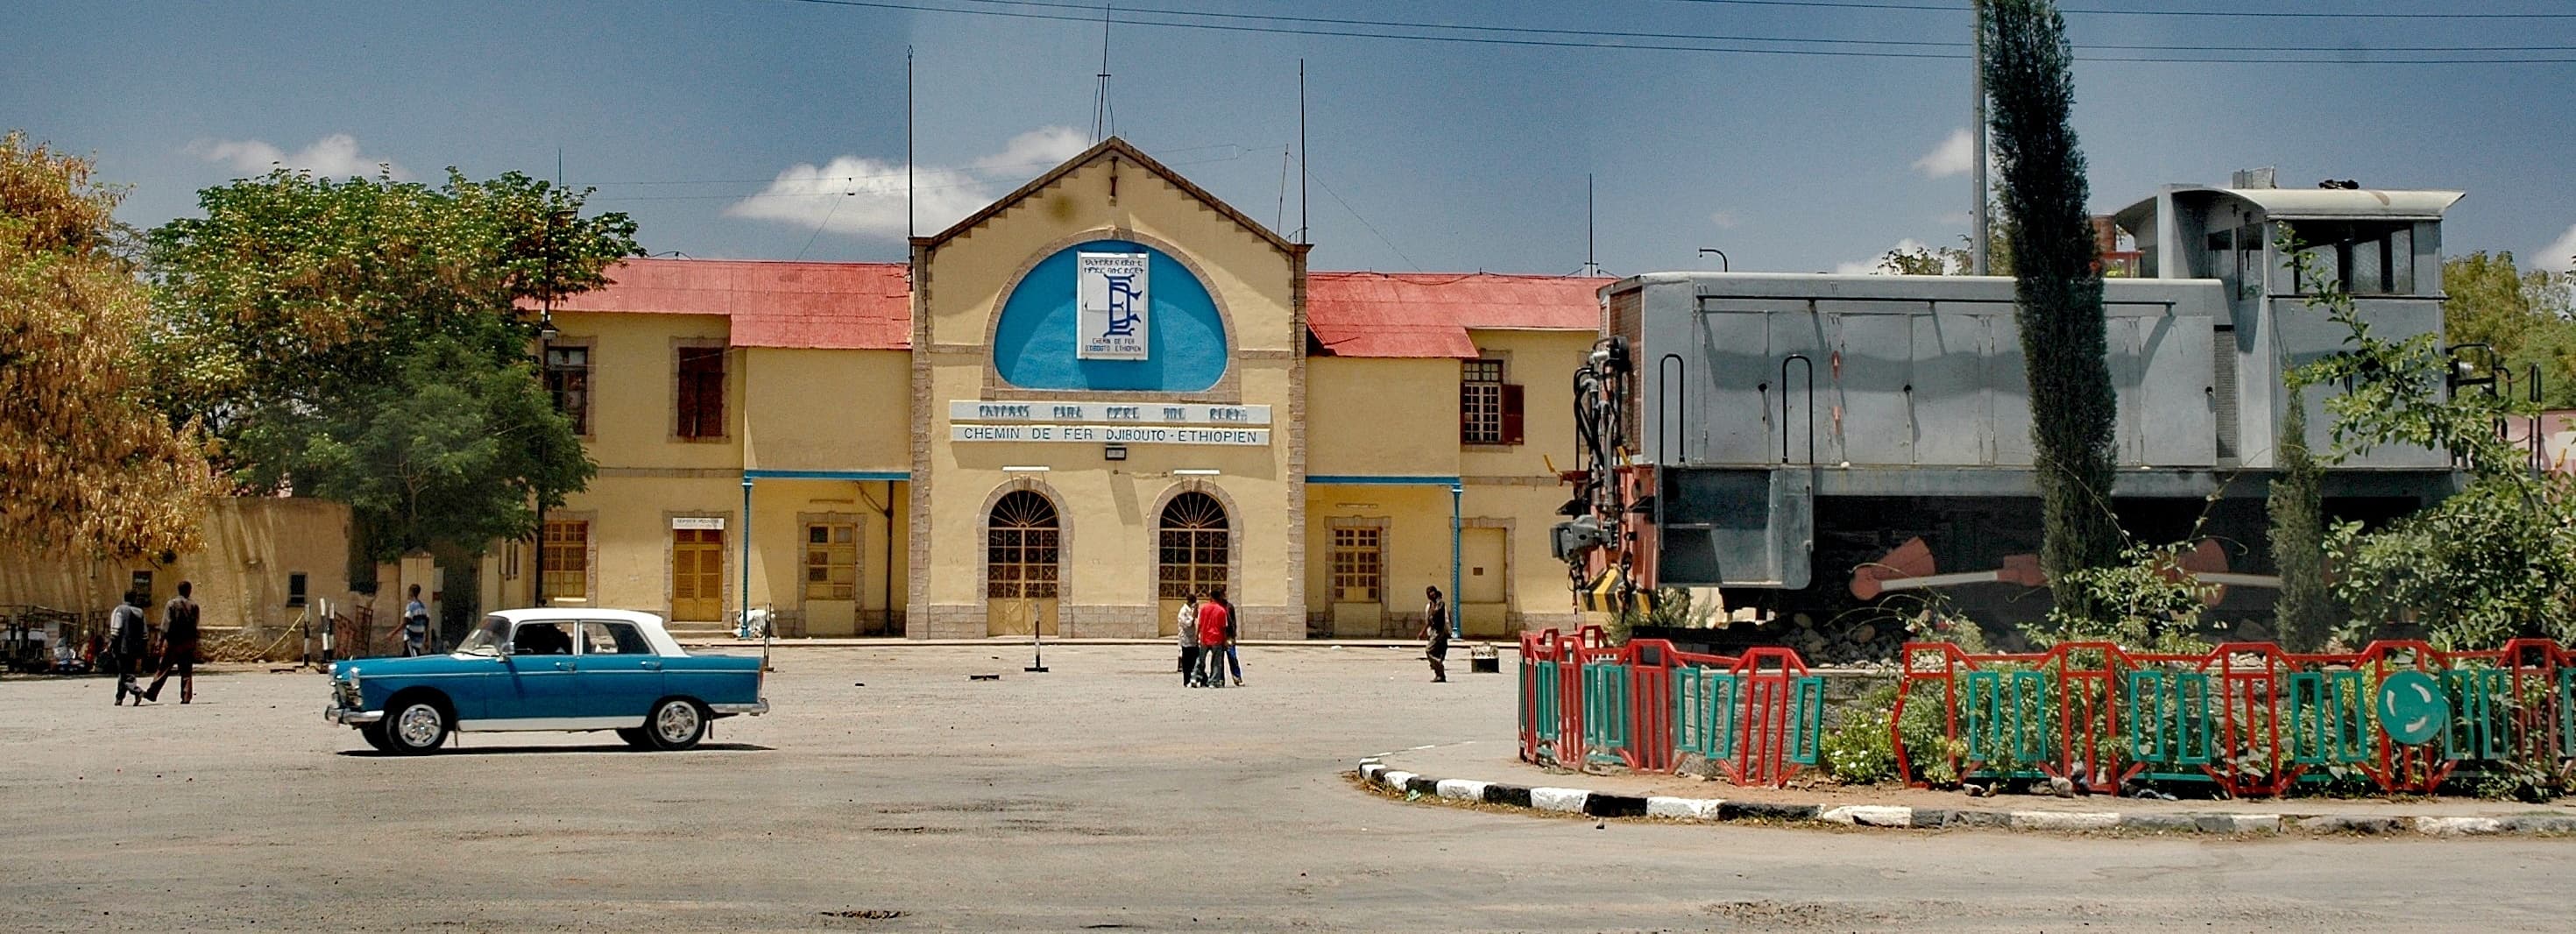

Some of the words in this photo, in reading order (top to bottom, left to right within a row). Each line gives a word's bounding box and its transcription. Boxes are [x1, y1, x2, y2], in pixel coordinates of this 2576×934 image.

[964, 428, 1020, 439] CHEMIN
[1031, 428, 1051, 440] DE
[1064, 428, 1093, 440] FER
[1106, 428, 1165, 441] DJIBOUTO
[1178, 430, 1257, 442] ETHIOPIEN
